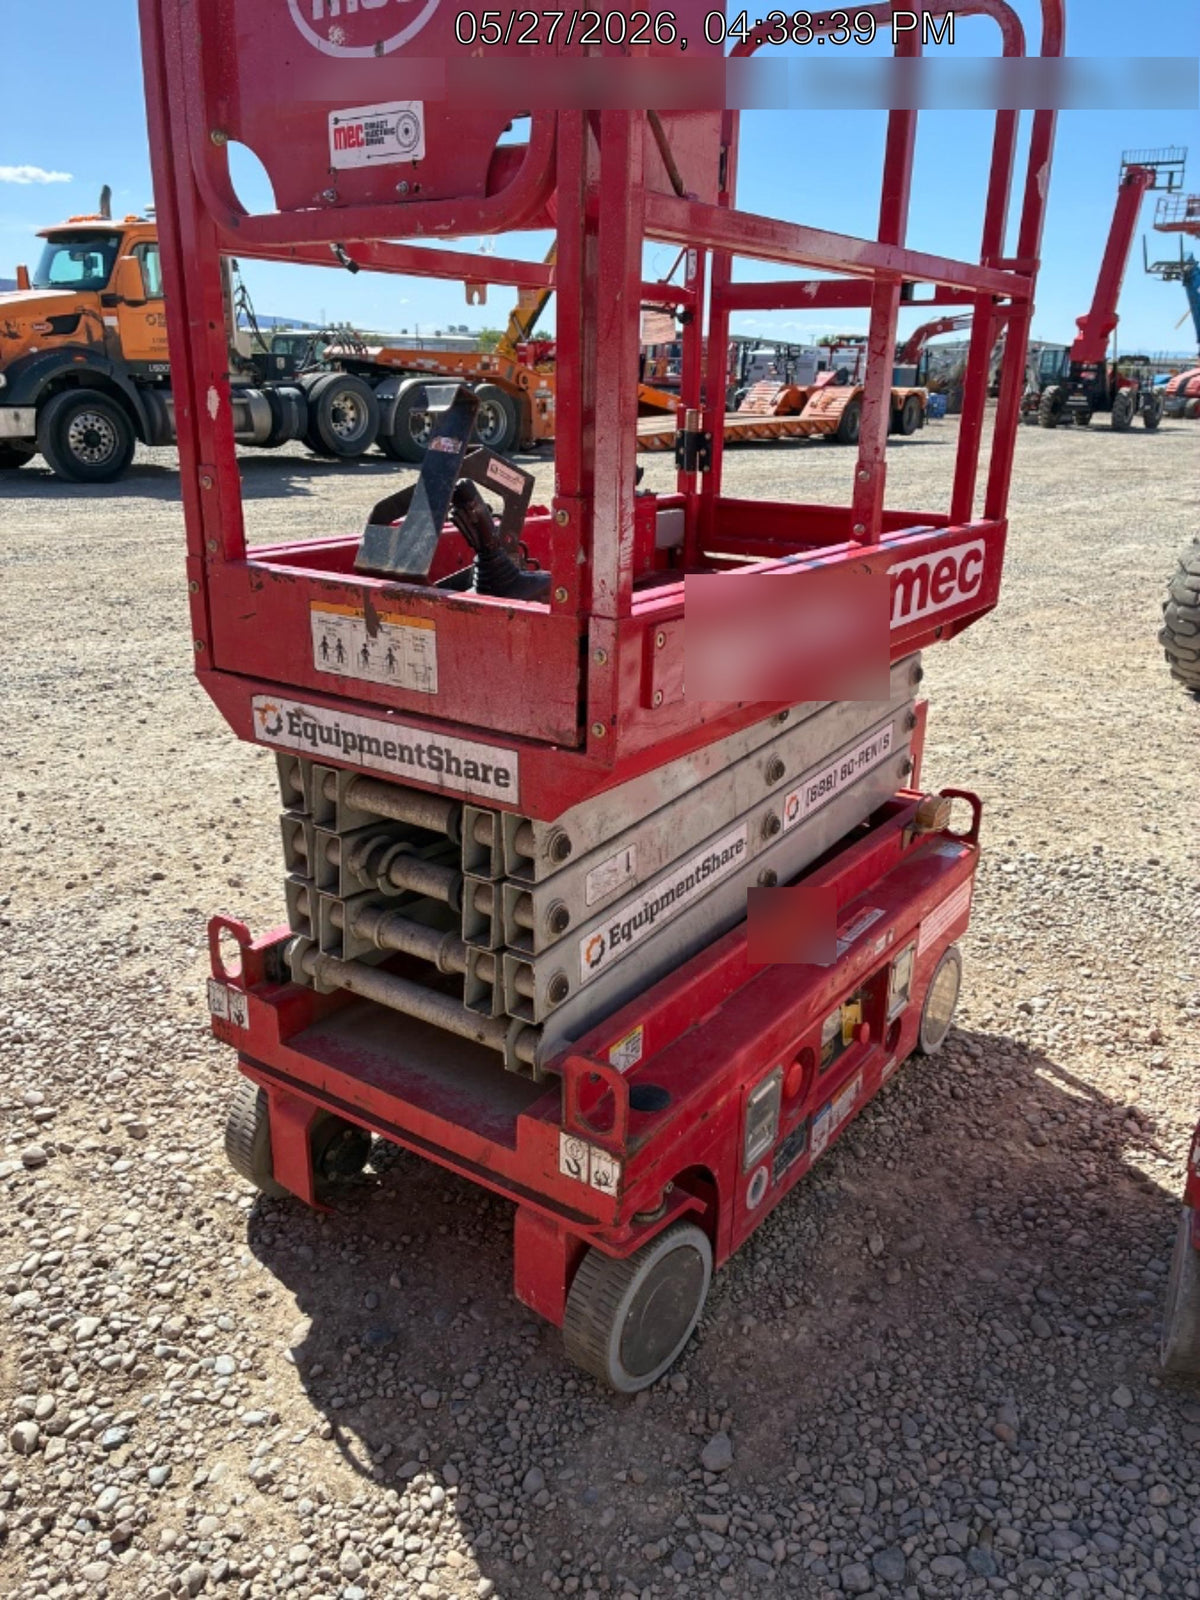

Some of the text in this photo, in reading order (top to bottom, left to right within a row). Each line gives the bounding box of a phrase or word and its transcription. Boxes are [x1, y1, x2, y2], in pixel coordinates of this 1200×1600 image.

[890, 547, 983, 619] mec
[287, 710, 511, 789] EquipmentShare
[608, 837, 745, 950] EquipmentShare
